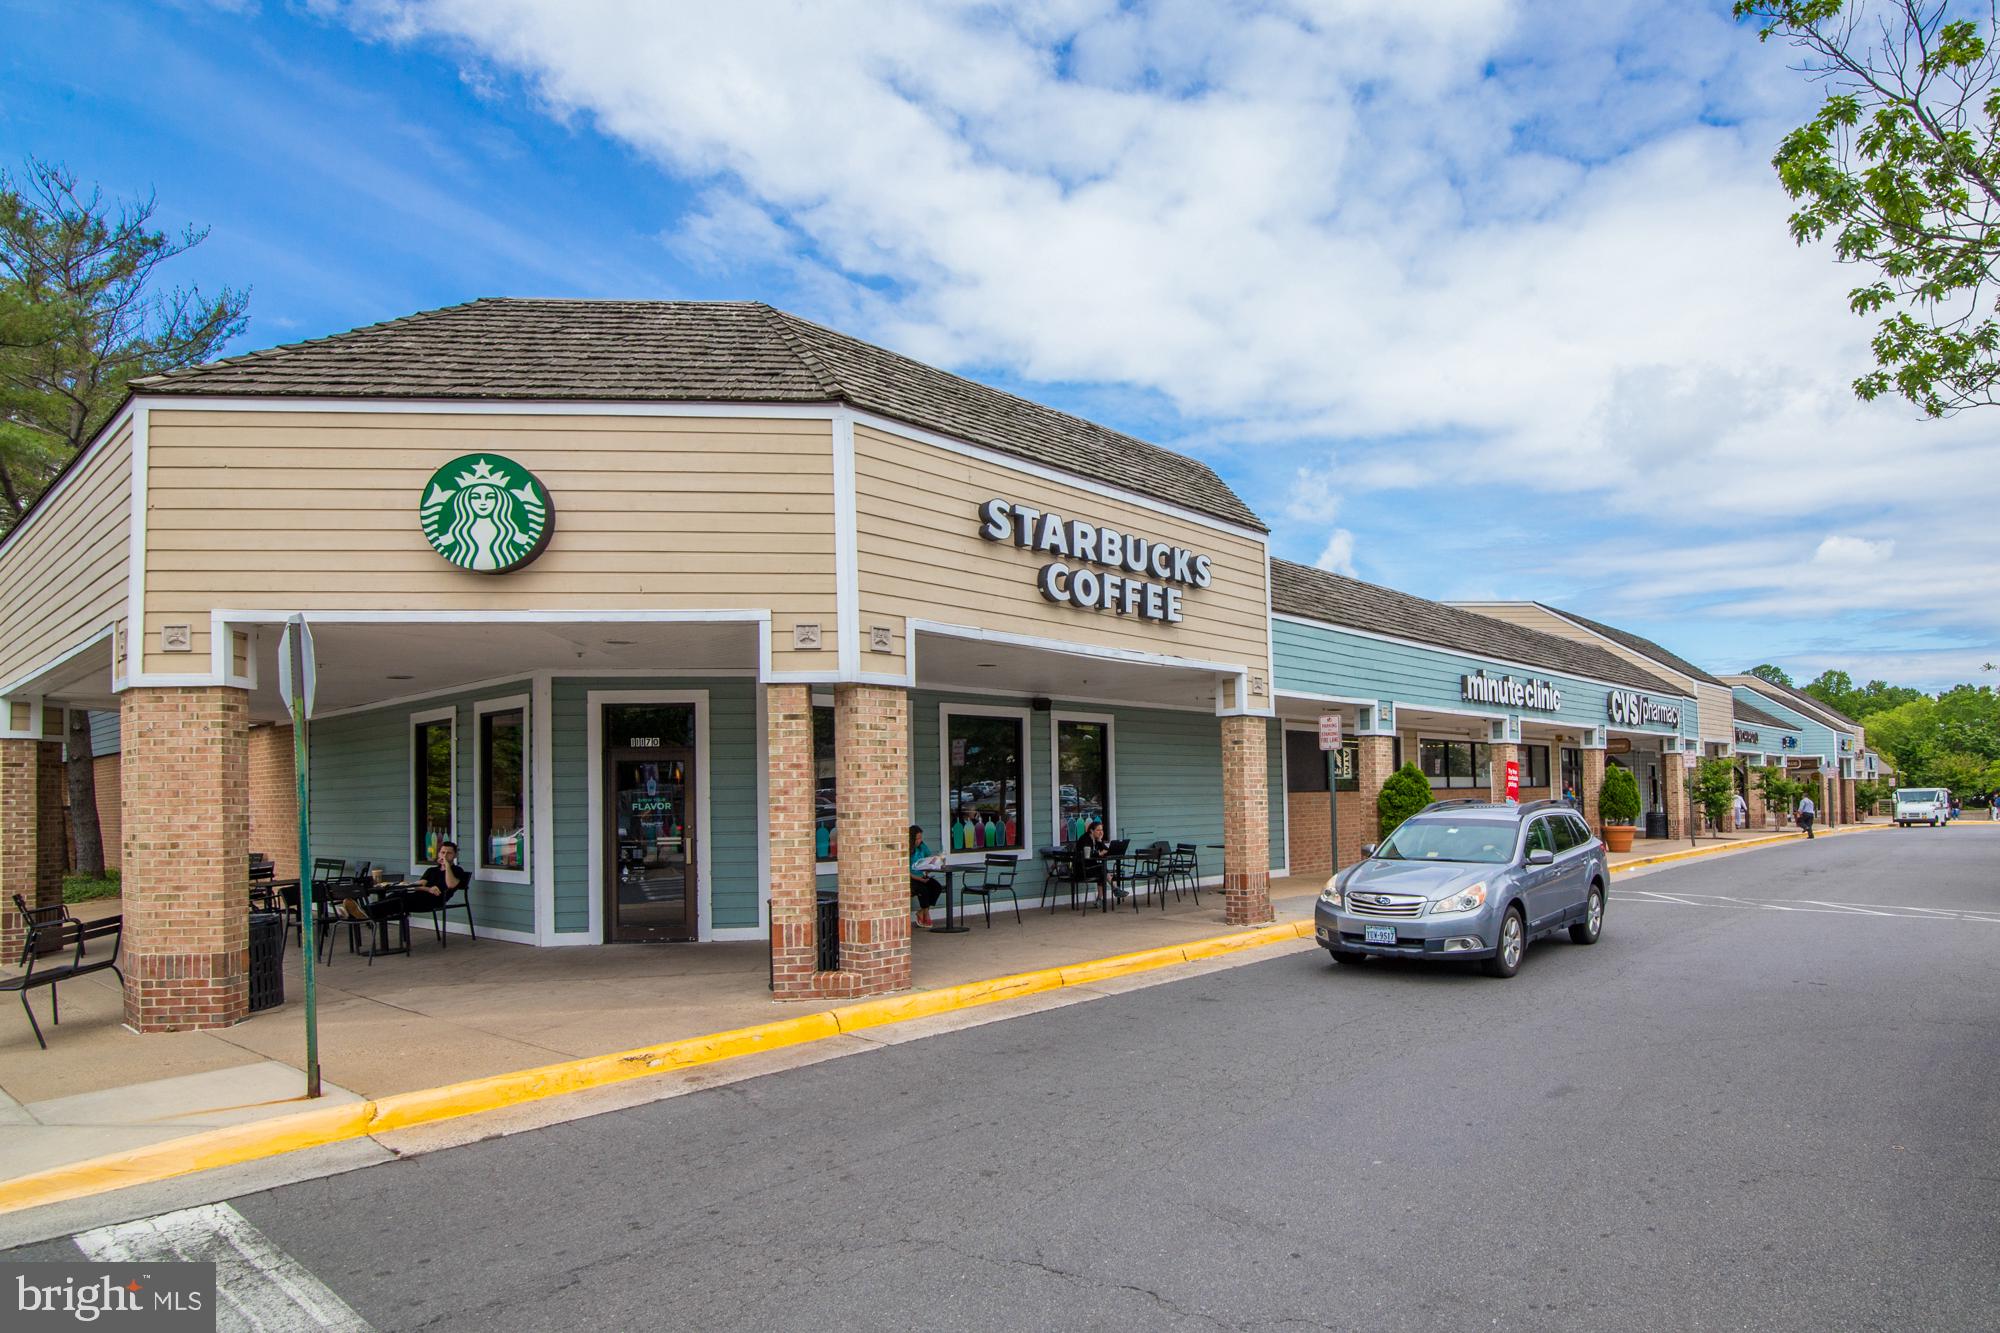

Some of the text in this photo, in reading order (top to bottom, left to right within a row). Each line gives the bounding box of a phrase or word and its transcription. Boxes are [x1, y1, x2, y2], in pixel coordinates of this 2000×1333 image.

[982, 498, 1212, 588] STARBUCKS
[1042, 562, 1183, 623] COFFEE
[1466, 669, 1561, 711] minute clinic
[632, 802, 672, 811] FLAVOR
